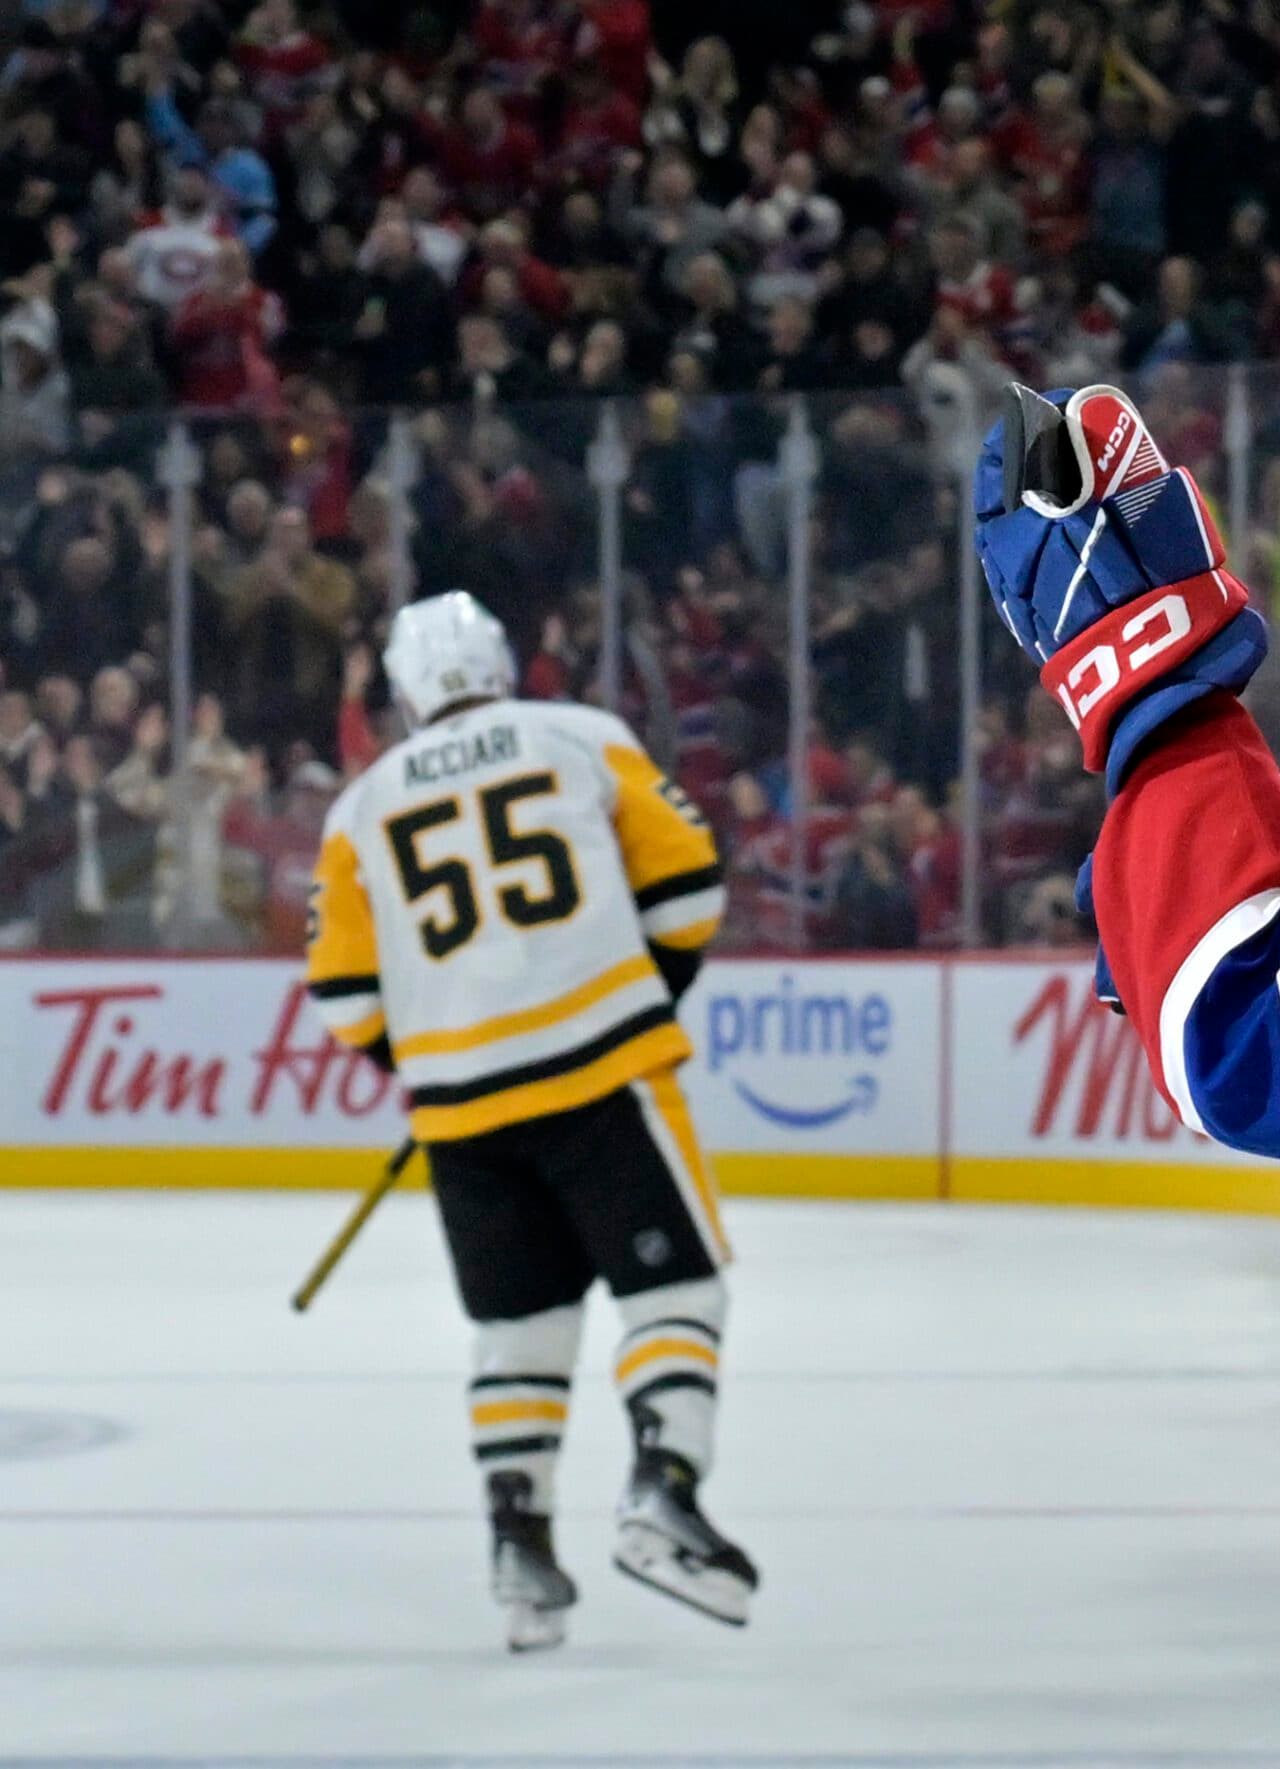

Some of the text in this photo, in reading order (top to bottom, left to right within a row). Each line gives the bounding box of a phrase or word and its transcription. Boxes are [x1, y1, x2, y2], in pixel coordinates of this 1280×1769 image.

[1098, 410, 1132, 473] CCM
[1058, 594, 1191, 731] CC
[404, 724, 522, 786] ACCIARI
[380, 768, 584, 961] 55
[33, 980, 410, 1118] Tim Ho
[708, 975, 893, 1073] prime
